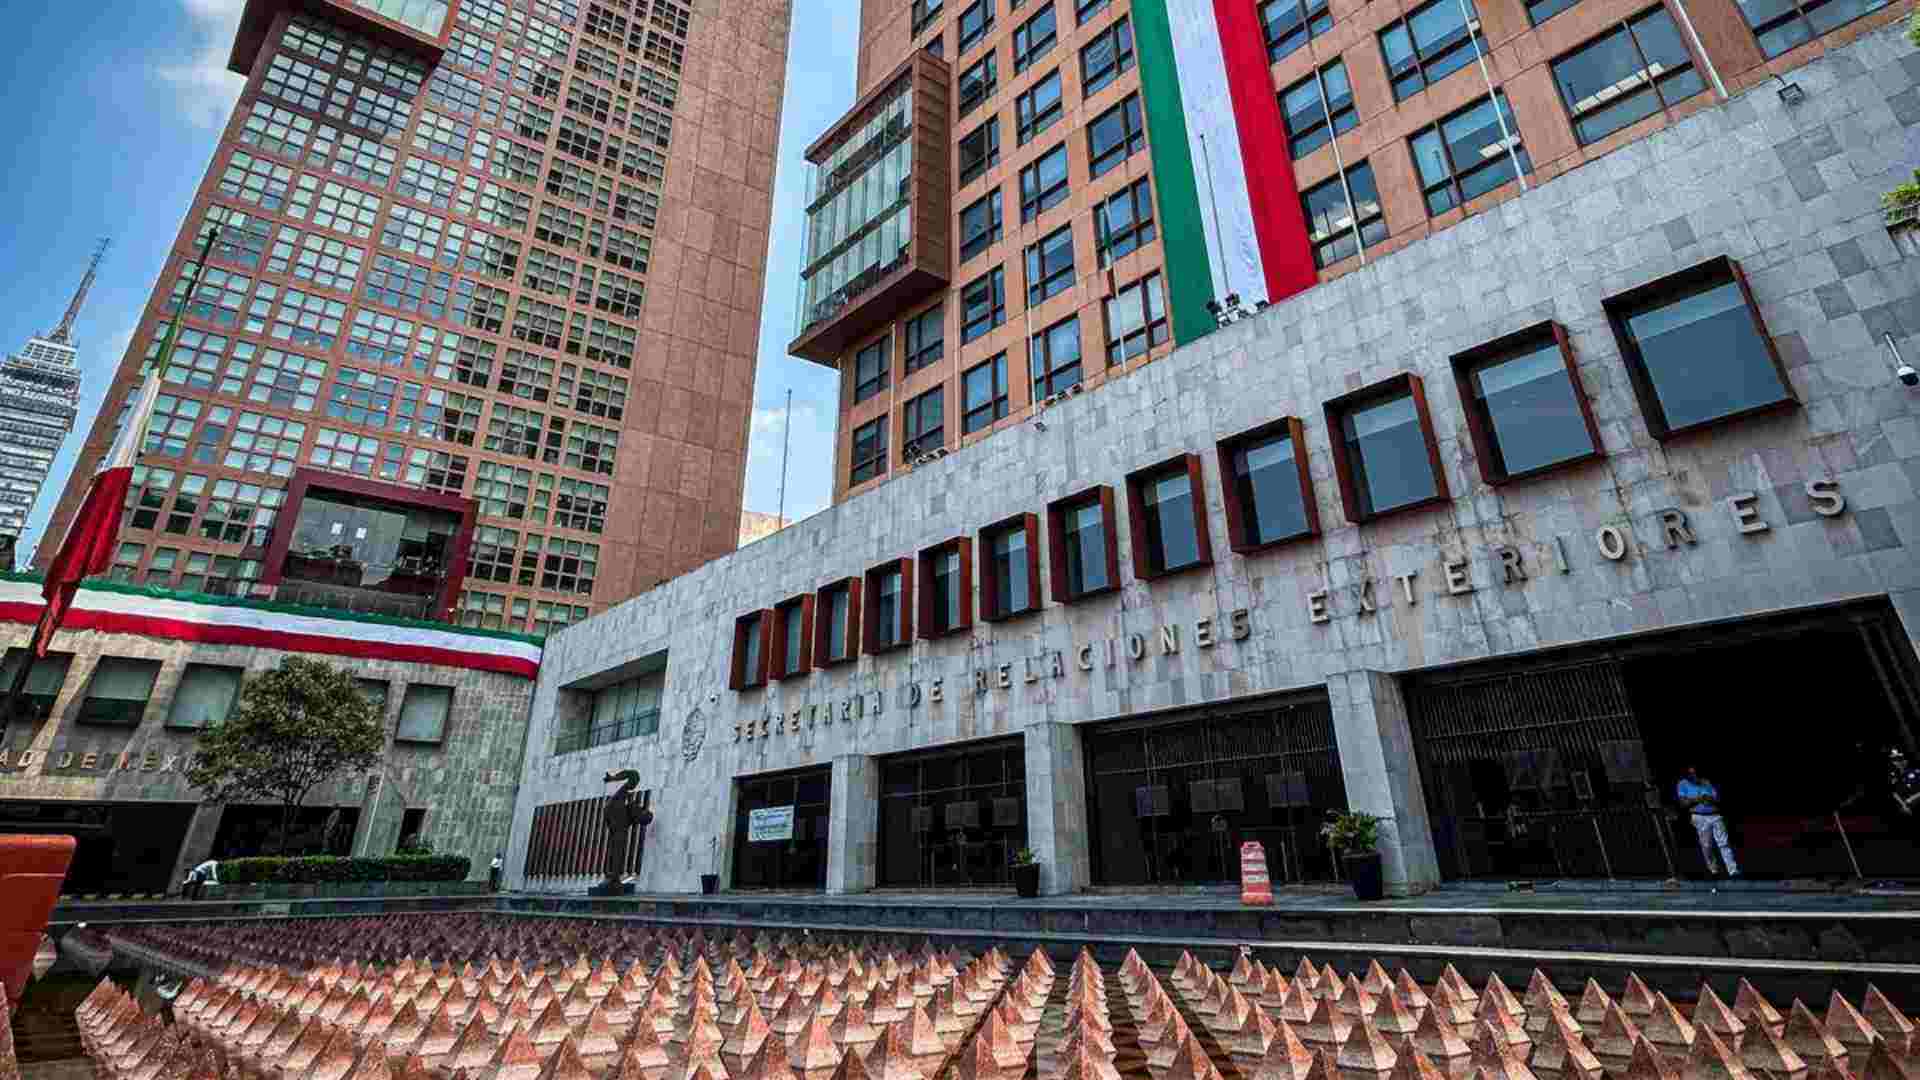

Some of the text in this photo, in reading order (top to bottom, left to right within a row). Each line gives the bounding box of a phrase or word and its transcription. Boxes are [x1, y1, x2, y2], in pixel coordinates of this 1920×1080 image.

[732, 480, 1845, 744] SECRETARIA DE RELACIONES EXTERIORES
[55, 751, 98, 769] DE
